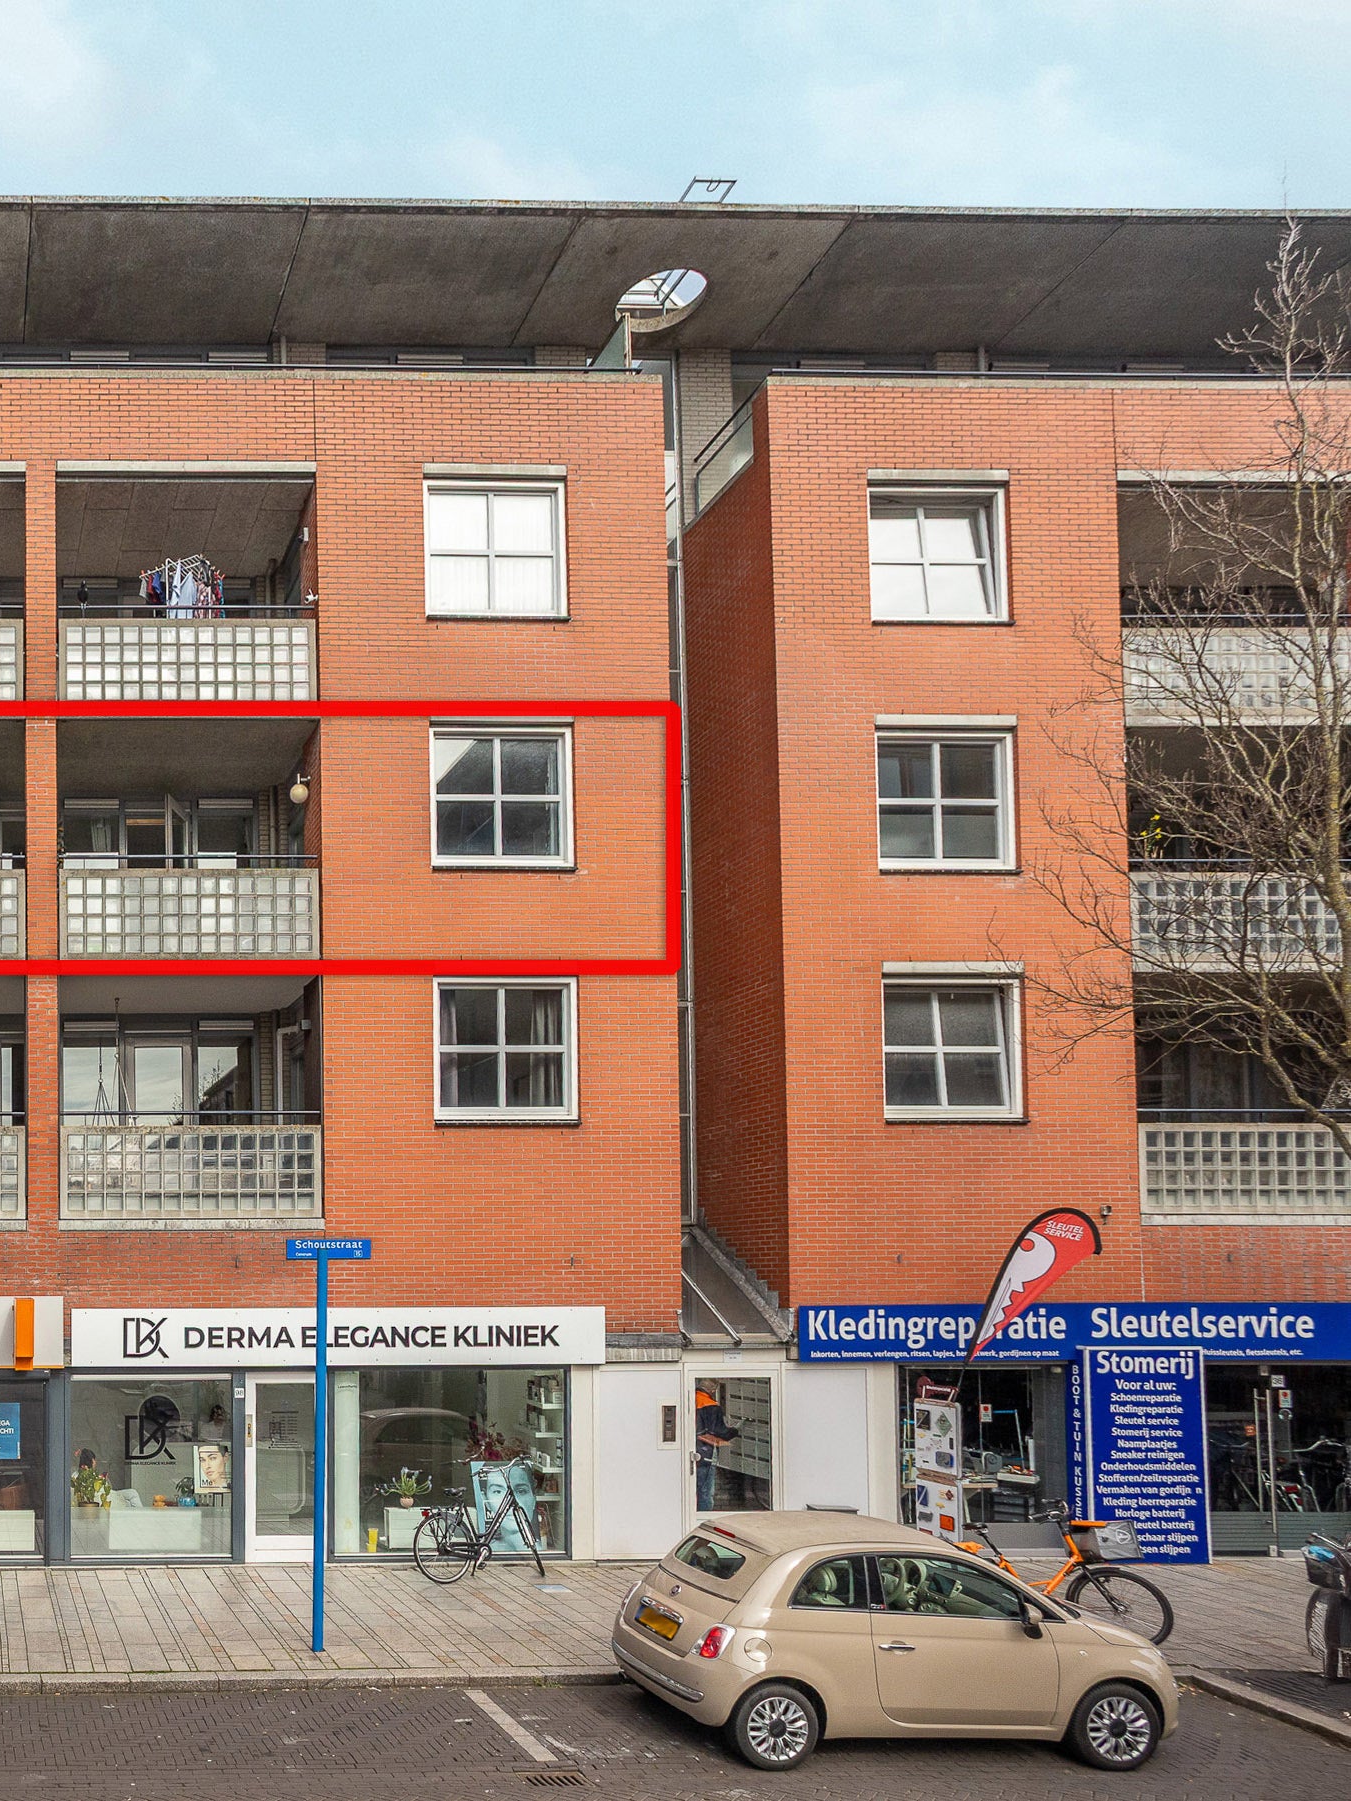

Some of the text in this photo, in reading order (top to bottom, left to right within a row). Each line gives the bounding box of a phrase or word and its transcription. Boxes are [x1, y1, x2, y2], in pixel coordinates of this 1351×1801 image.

[1047, 1220, 1083, 1233] SLEUTEL
[1044, 1228, 1083, 1241] SERVICE
[295, 1240, 363, 1249] Schoutstraat
[808, 1306, 1315, 1349] Kledingrepatie Sleutelservice
[184, 1326, 295, 1349] DERMA
[453, 1325, 560, 1348] KLINIEK
[873, 1350, 909, 1359] verlengen,
[910, 1350, 932, 1358] ritsen,
[932, 1349, 955, 1358] lapjes,
[999, 1349, 1031, 1358] gordijnen
[1031, 1350, 1041, 1358] op
[1096, 1350, 1194, 1380] Stomerij
[1071, 1364, 1081, 1405] BOOT
[1115, 1379, 1177, 1390] Voor al uw:
[1110, 1392, 1183, 1403] Schoenreparatie
[1072, 1408, 1082, 1418] &
[1109, 1404, 1185, 1415] Kledingreparatie
[1114, 1415, 1180, 1426] Sleutel service
[1111, 1427, 1184, 1438] Stomerij service
[1073, 1421, 1082, 1462] TUIN
[1117, 1439, 1179, 1450] Naamplaatjes
[1110, 1450, 1186, 1461] Sneaker reinigen
[1100, 1461, 1197, 1471] Onderhoudsmiddelen
[1098, 1473, 1200, 1484] Stofferen/zeilreparatie
[1096, 1485, 1140, 1494] Vermaken
[1142, 1486, 1158, 1494] van
[1102, 1497, 1197, 1507] Kleding leerreparatie
[1114, 1509, 1186, 1519] Horloge batterij
[1133, 1521, 1195, 1531] leutel batterij
[1167, 1533, 1199, 1544] slijpen
[1159, 1545, 1191, 1556] slijpen
